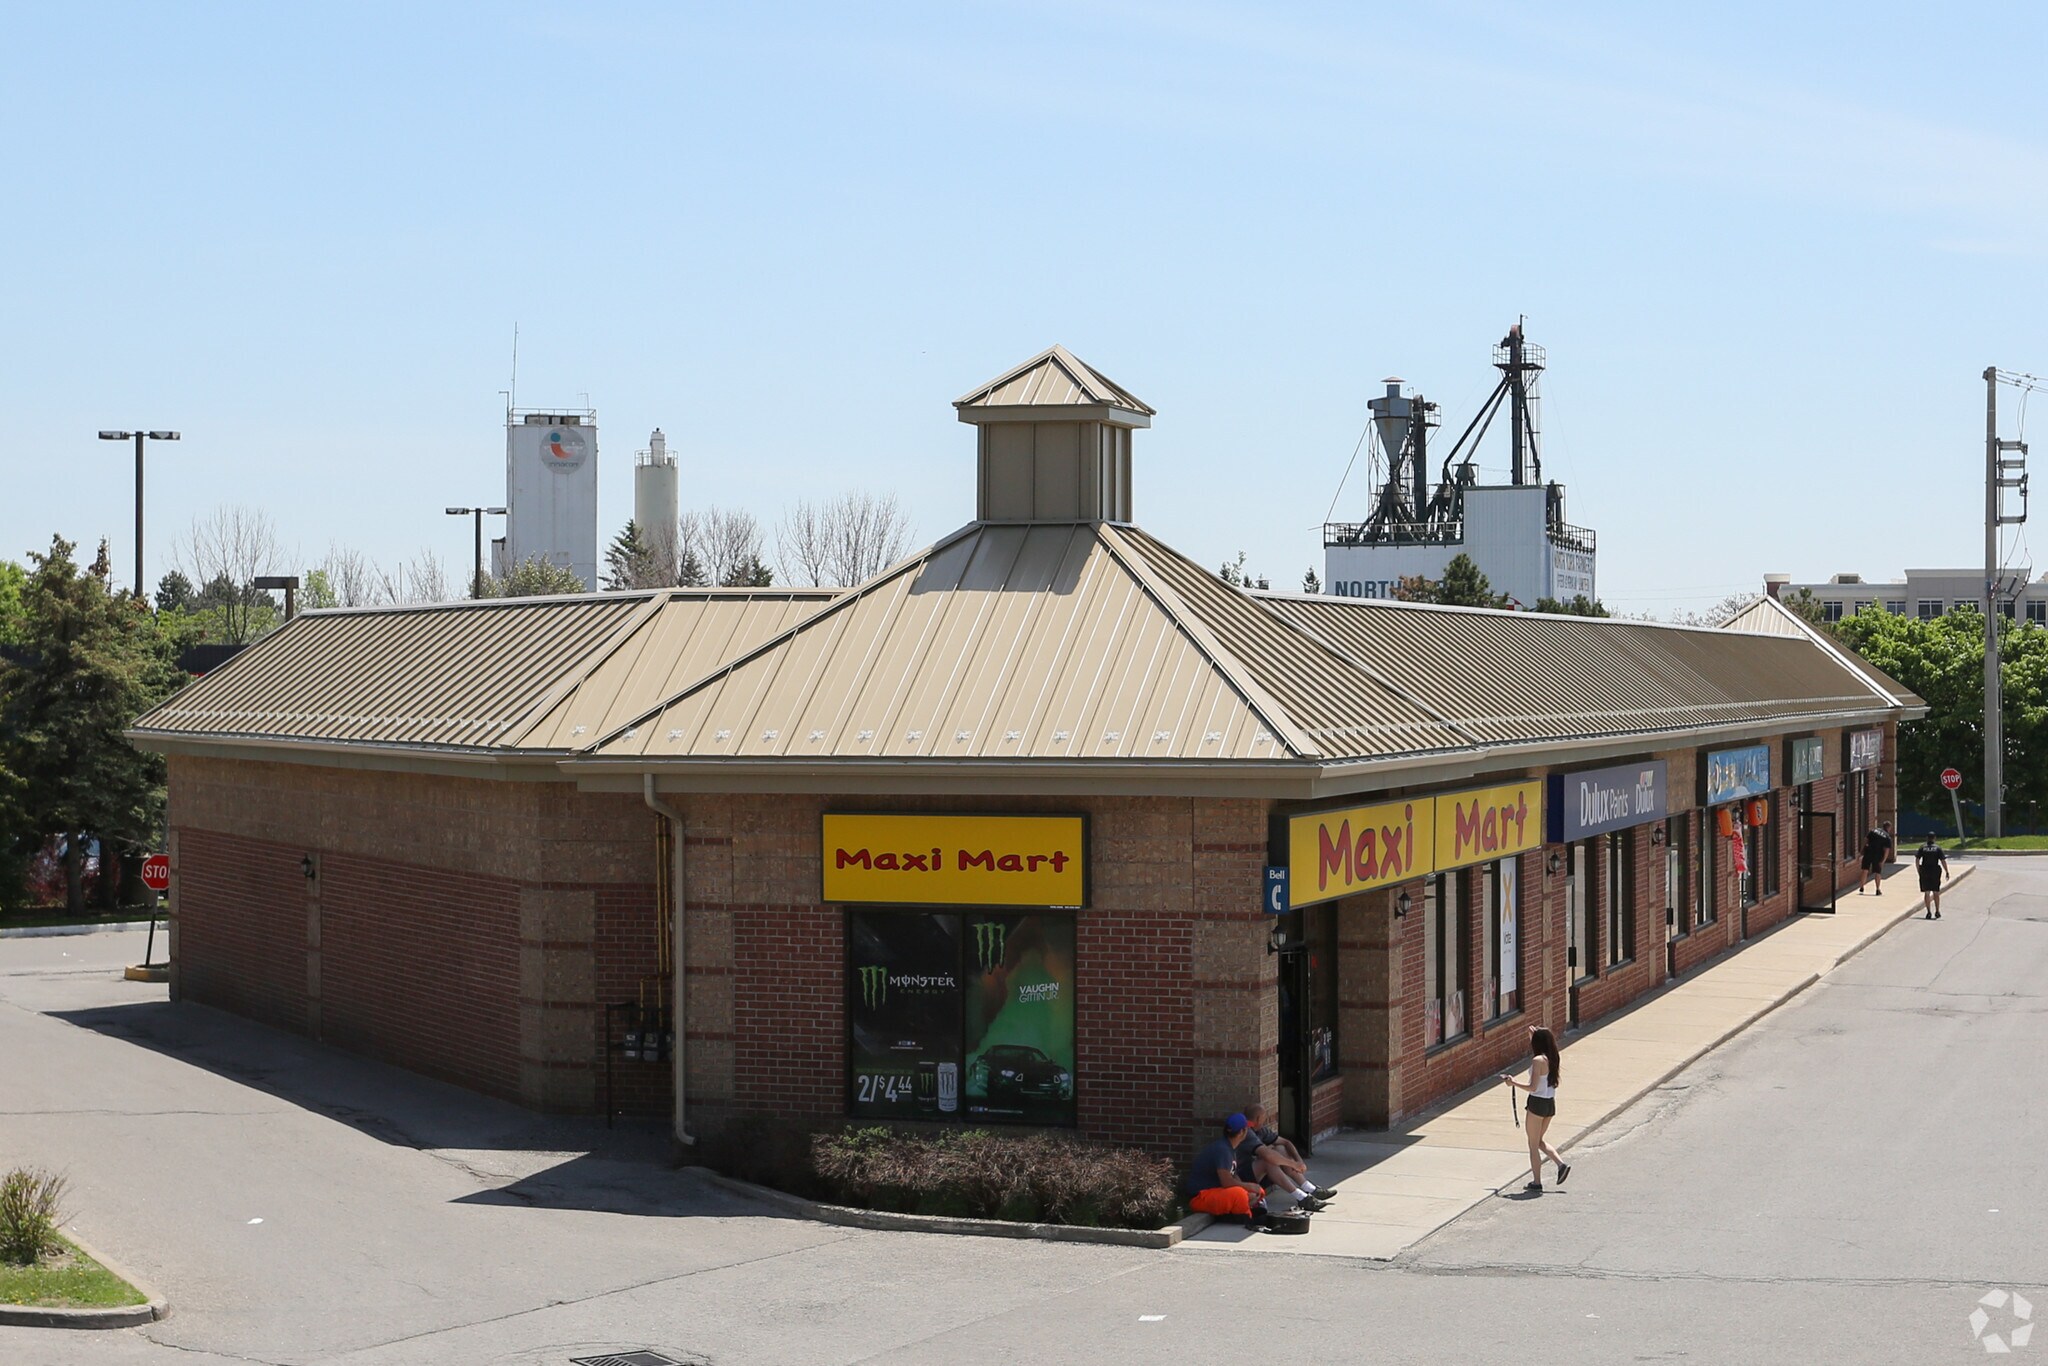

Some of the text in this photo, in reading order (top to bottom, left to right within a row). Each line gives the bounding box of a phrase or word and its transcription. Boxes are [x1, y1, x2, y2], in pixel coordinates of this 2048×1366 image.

[1942, 774, 1960, 784] STOP
[1580, 781, 1629, 827] Dulux Paints
[1635, 783, 1655, 814] Dulux
[1318, 791, 1528, 891] Maxi Mart
[835, 848, 1070, 874] Maxi Mart
[145, 864, 170, 879] STO
[1269, 869, 1285, 880] Bell
[889, 973, 956, 988] MONSTER
[1019, 982, 1060, 994] VAUGHN
